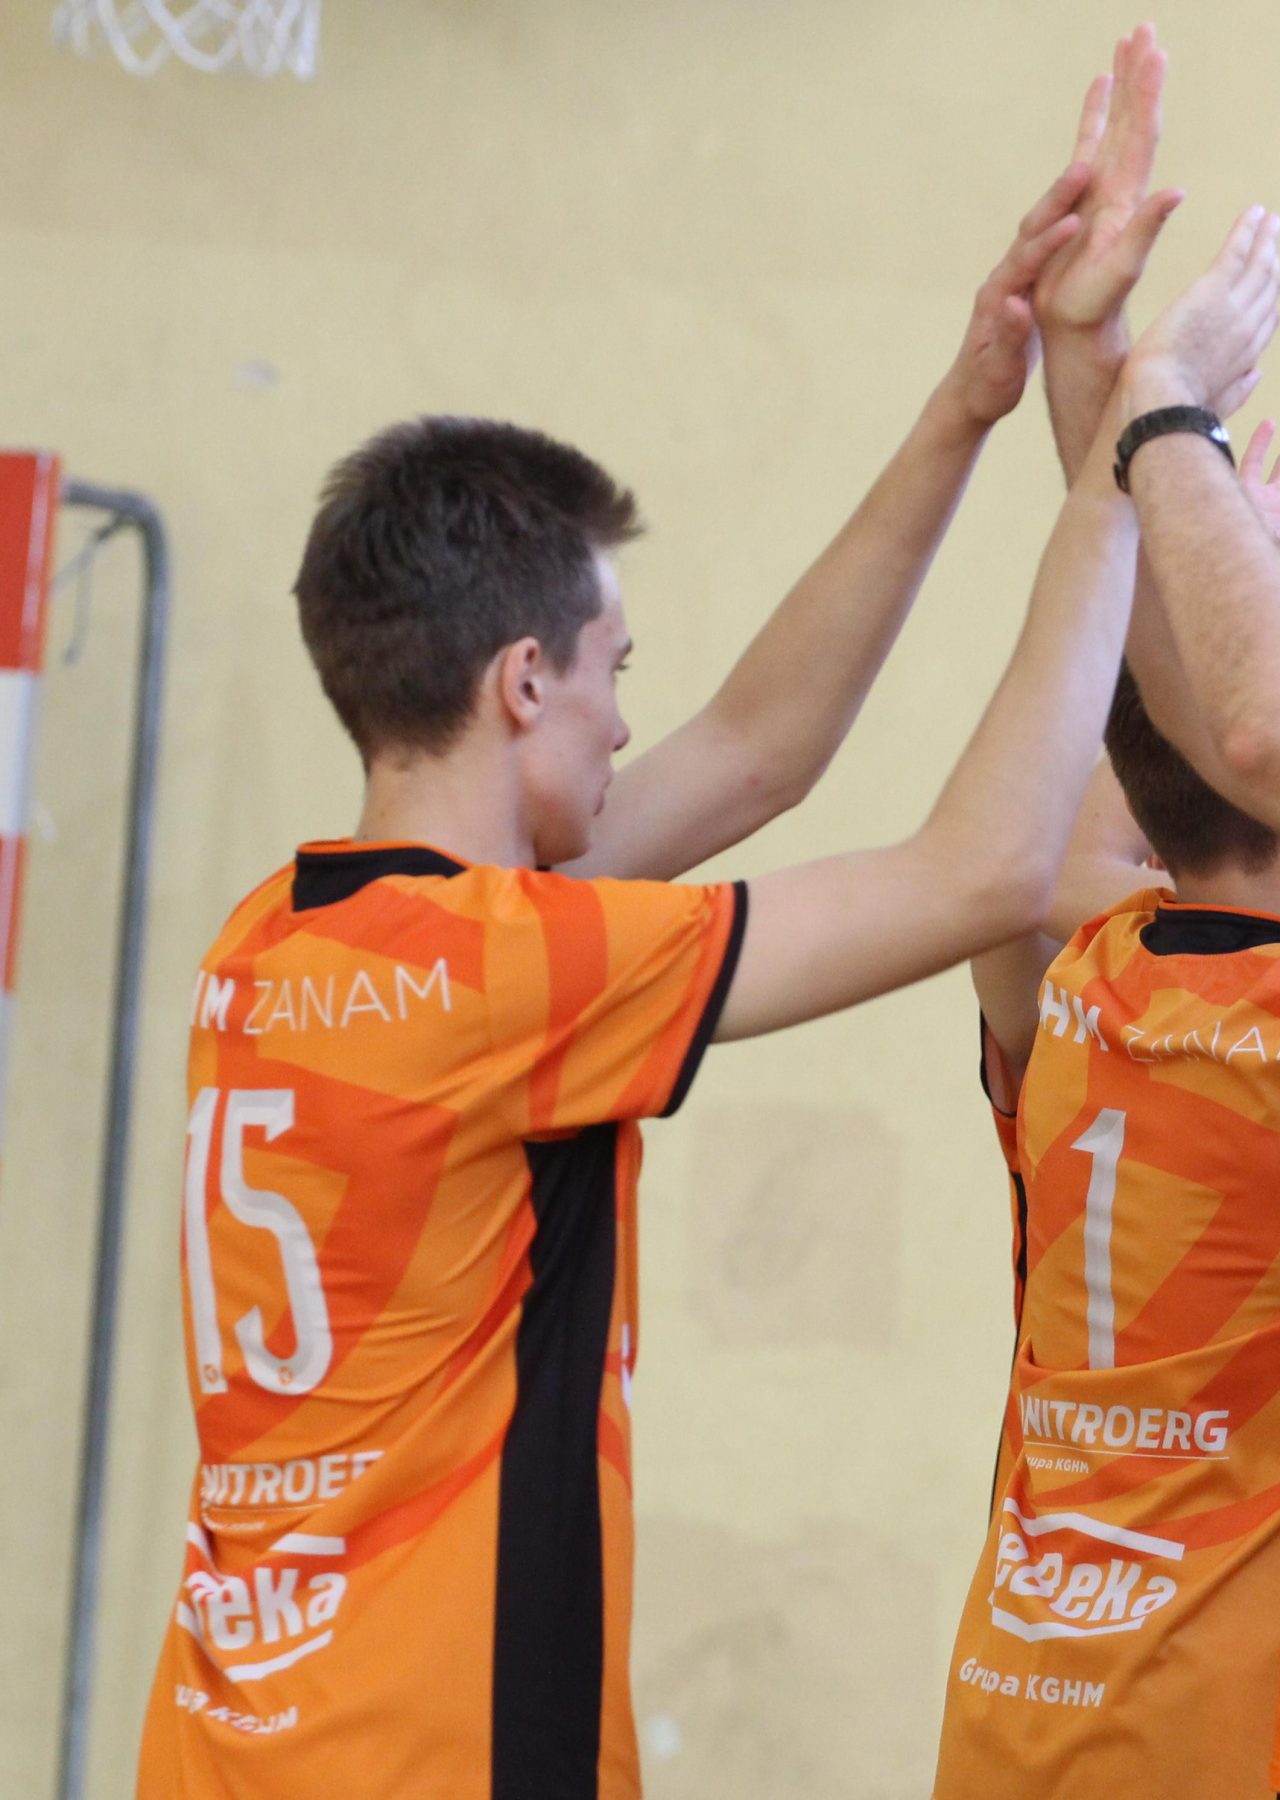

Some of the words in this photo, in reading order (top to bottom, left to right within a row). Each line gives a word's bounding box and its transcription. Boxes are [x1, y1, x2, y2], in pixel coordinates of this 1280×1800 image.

[241, 956, 454, 1036] ZANAM
[186, 1087, 334, 1396] 15
[1069, 1107, 1127, 1369] 1
[1026, 1454, 1053, 1470] rupa
[1055, 1457, 1090, 1474] KGHM
[1025, 1673, 1106, 1708] KGHM
